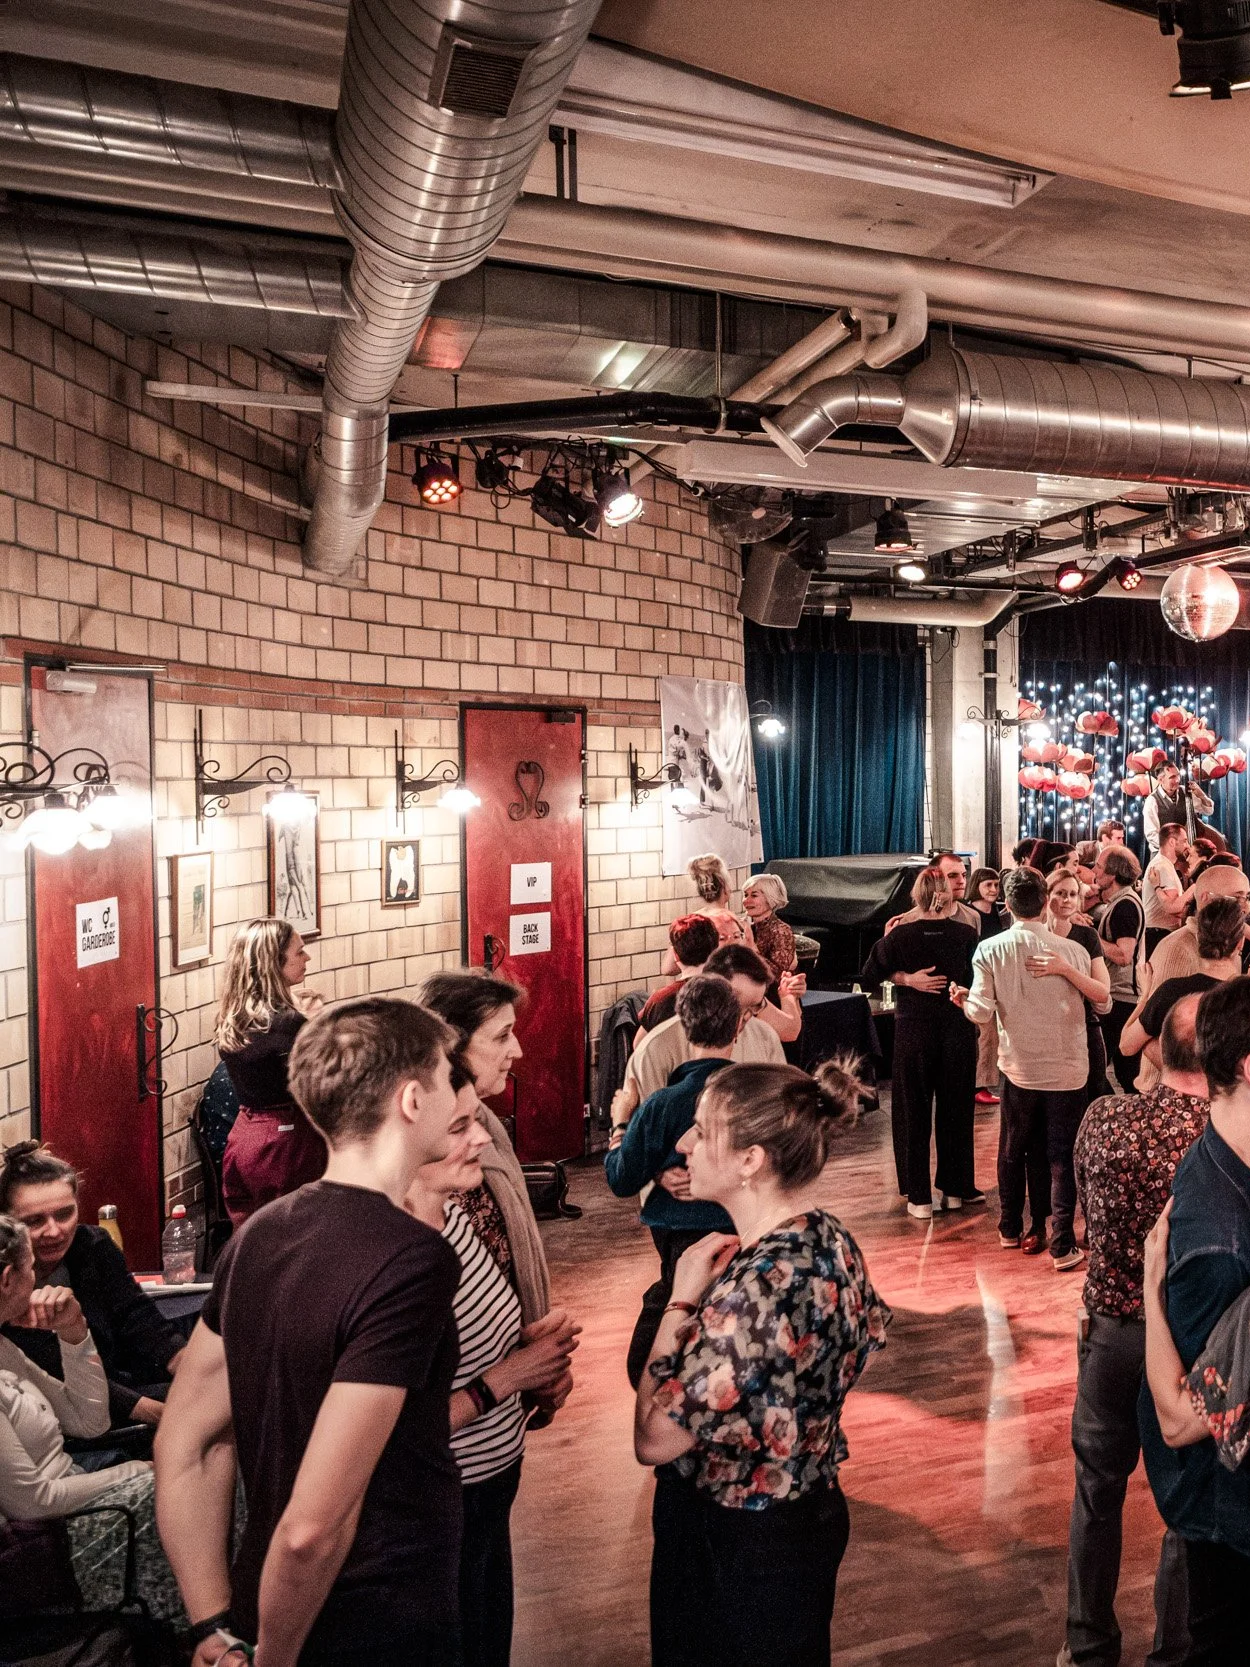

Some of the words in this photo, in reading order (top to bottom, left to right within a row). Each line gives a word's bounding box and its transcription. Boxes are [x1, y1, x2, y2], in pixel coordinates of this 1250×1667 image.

[527, 876, 537, 887] VIP
[82, 918, 92, 934] WC
[523, 923, 539, 934] BACK
[82, 930, 116, 951] GARDEROBE
[521, 934, 539, 945] STAGE
